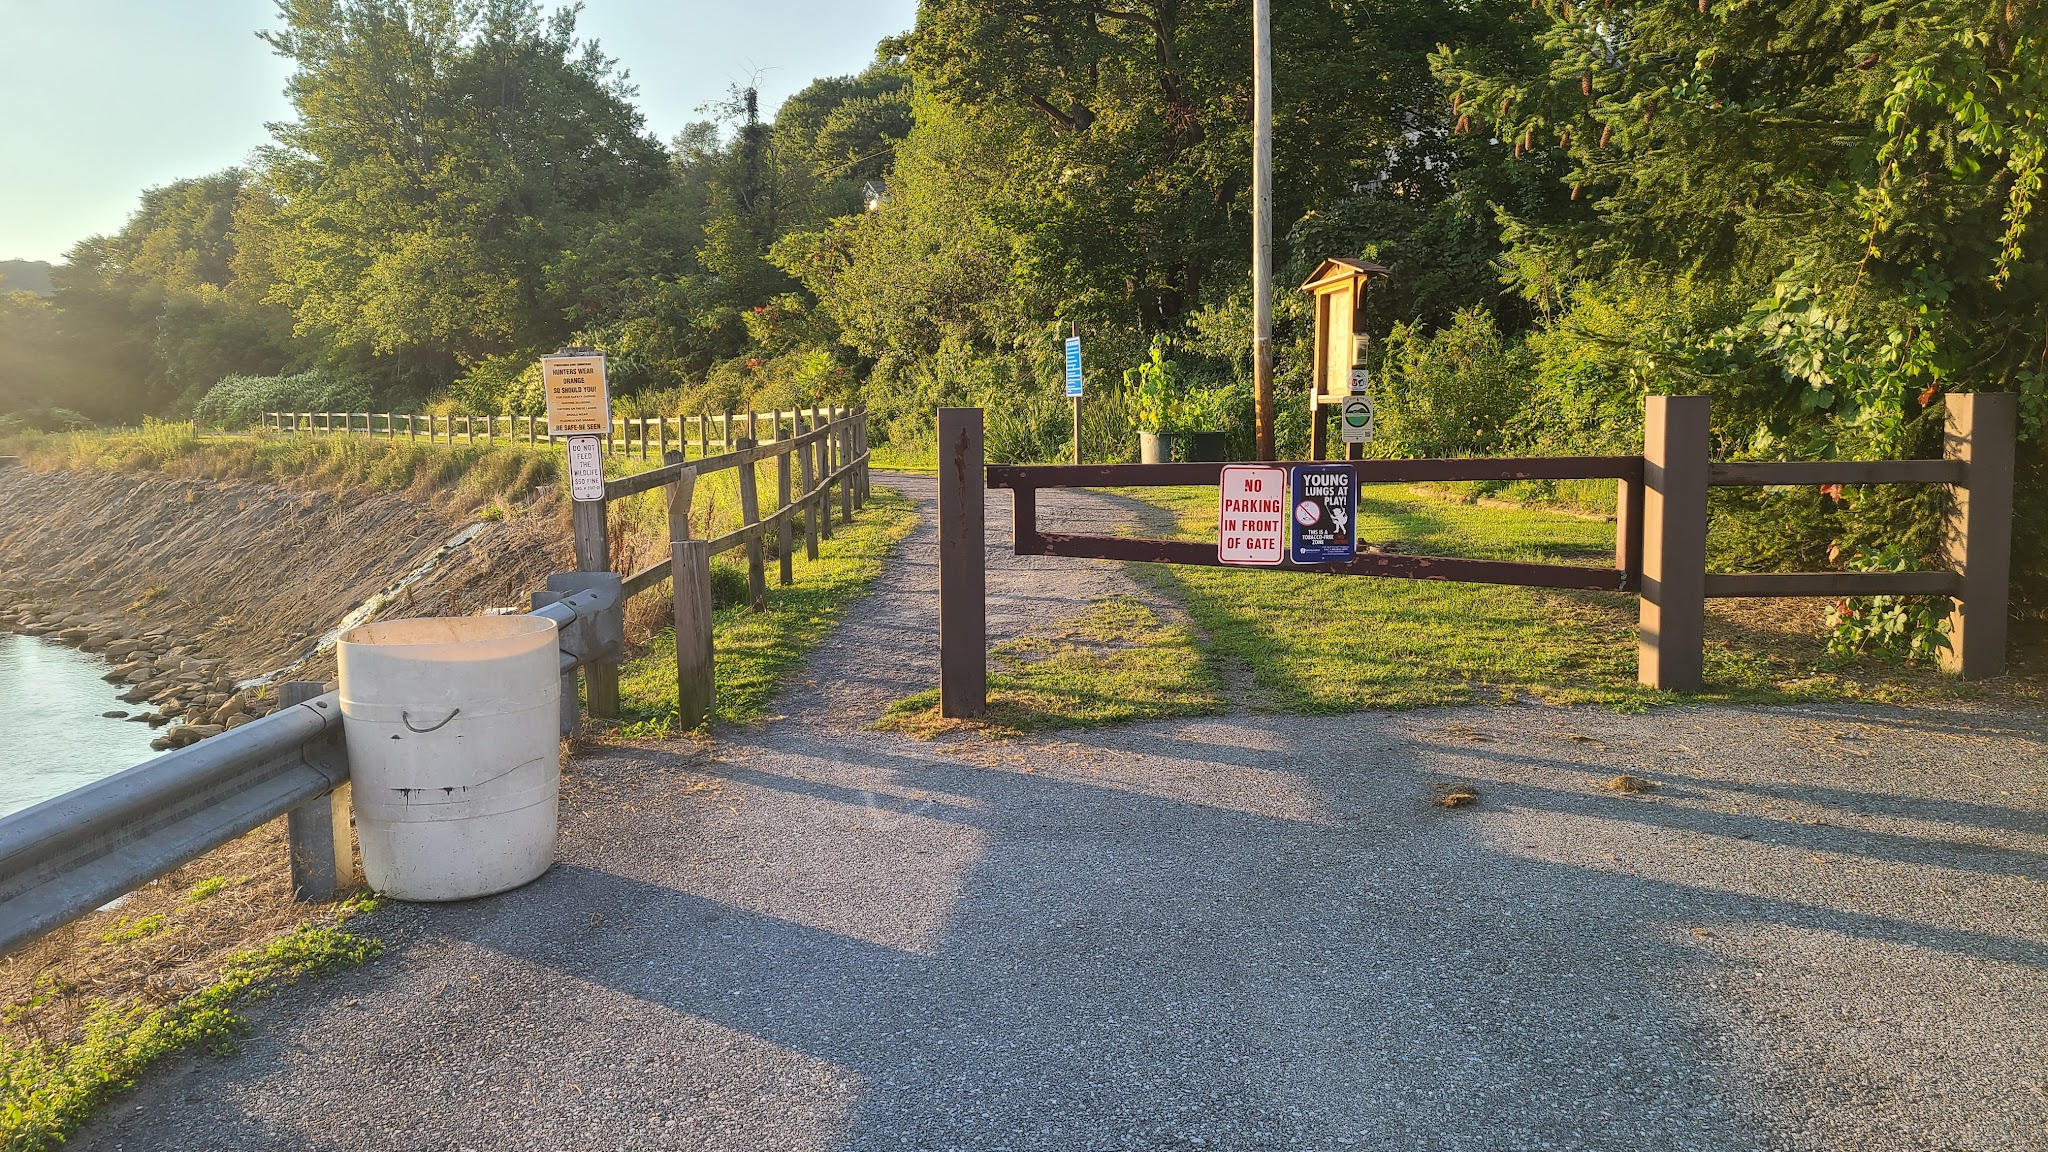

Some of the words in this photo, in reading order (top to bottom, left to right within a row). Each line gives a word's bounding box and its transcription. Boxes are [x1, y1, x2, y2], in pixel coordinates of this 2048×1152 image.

[1303, 474, 1348, 486] YOUNG
[1245, 480, 1262, 492] NO
[1305, 487, 1334, 496] LUNGS
[1338, 487, 1348, 495] AT
[1226, 500, 1280, 512] PARKING
[1325, 497, 1346, 505] PLAY!
[1225, 520, 1236, 531] IN
[1242, 520, 1279, 531] FRONT
[1227, 538, 1240, 549] OF
[1247, 538, 1275, 549] GATE
